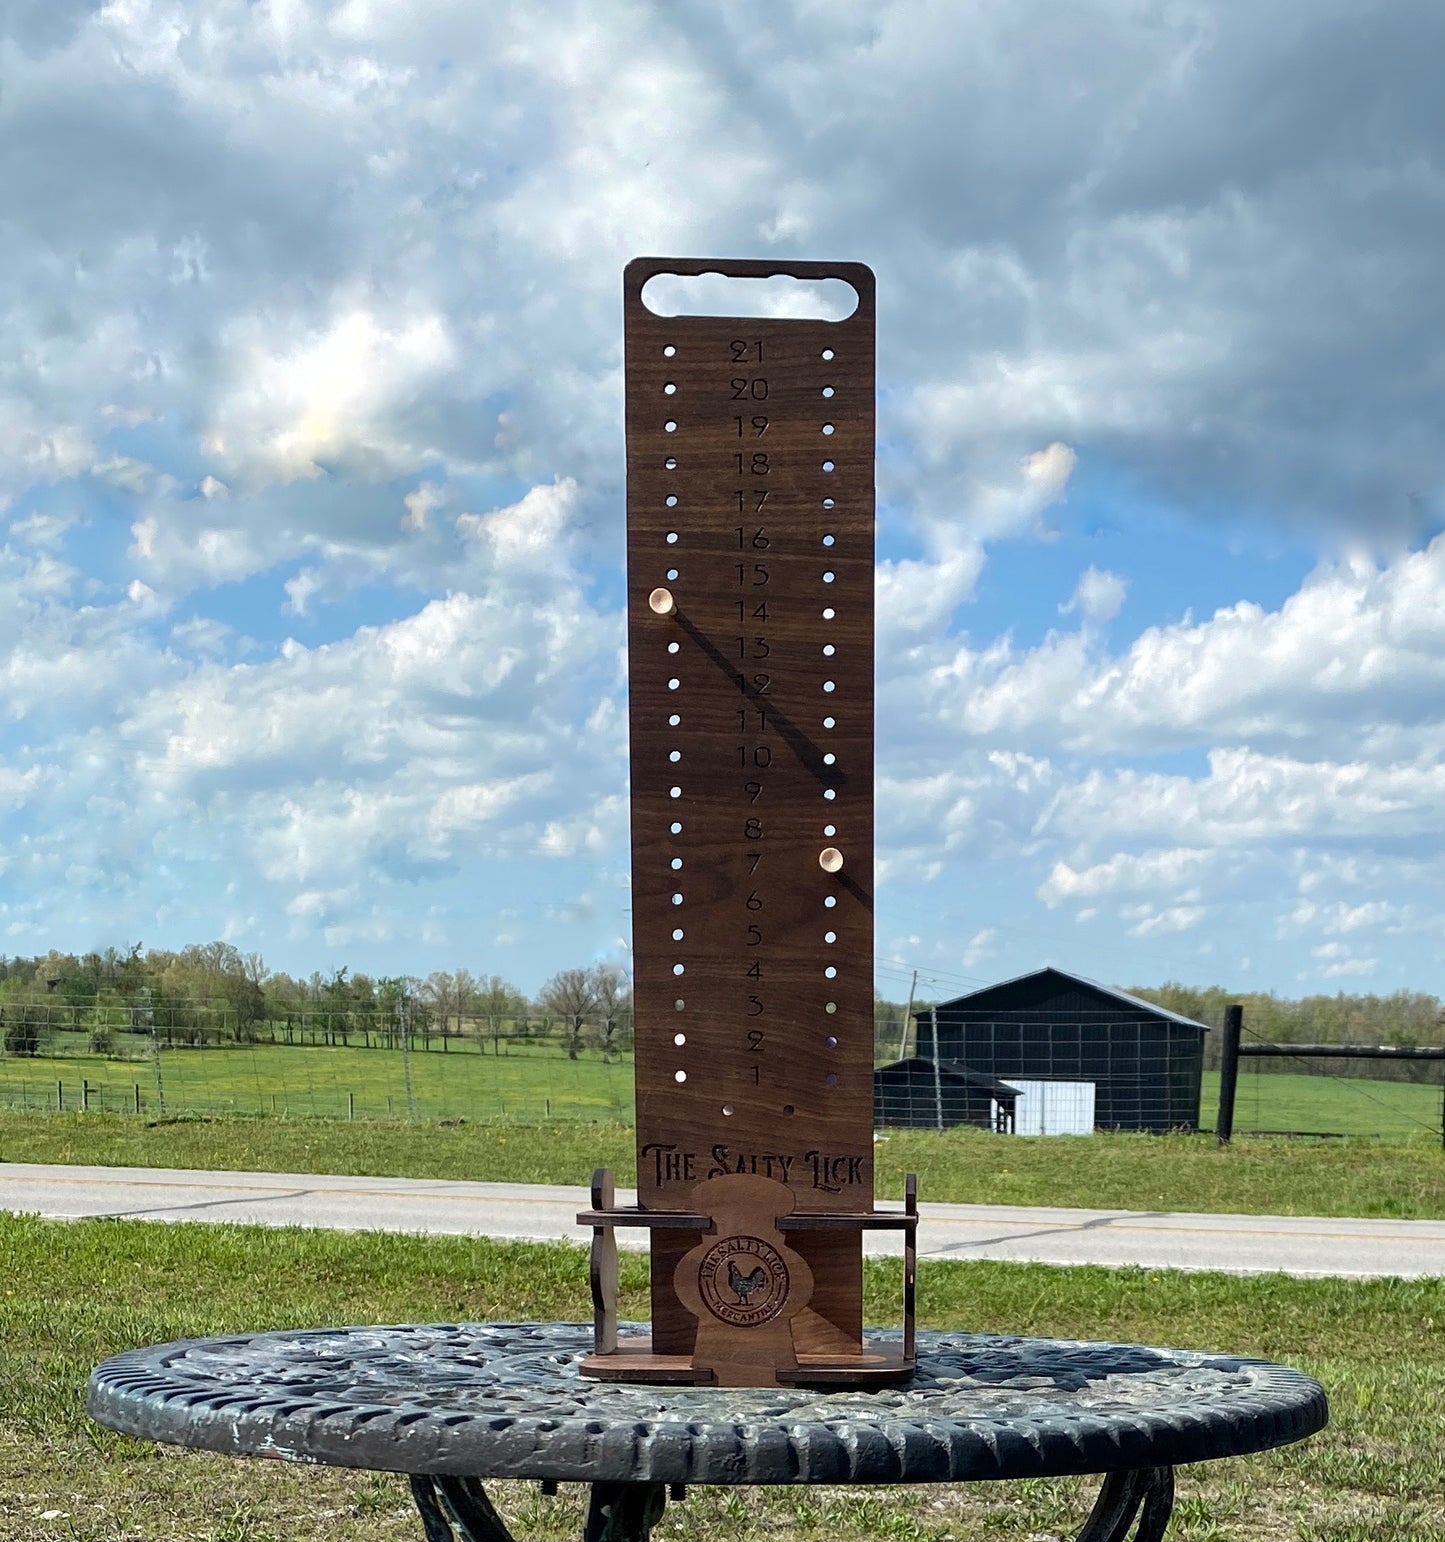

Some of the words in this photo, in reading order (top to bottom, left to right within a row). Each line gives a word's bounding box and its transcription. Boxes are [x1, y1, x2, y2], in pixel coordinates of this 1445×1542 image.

[730, 340, 763, 363] 21
[731, 378, 769, 400] 20
[734, 416, 769, 438] 19
[735, 453, 770, 475] 18
[734, 490, 769, 512] 17
[735, 527, 771, 549] 16
[735, 564, 769, 586] 15
[736, 601, 769, 622] 14
[736, 637, 770, 659] 13
[736, 674, 771, 695] 12
[737, 710, 766, 732] 11
[738, 746, 772, 768] 10
[745, 782, 763, 804] 9
[744, 818, 763, 839] 8
[747, 854, 762, 875] 7
[746, 890, 762, 911] 6
[746, 925, 762, 946] 5
[746, 961, 763, 982] 4
[748, 996, 764, 1016] 3
[747, 1030, 765, 1051] 2
[751, 1066, 760, 1086] 1
[642, 1144, 697, 1187] THE
[805, 1150, 864, 1194] LICK
[701, 1253, 720, 1278] THE
[717, 1240, 765, 1257] SALTY
[763, 1250, 785, 1281] LICK
[713, 1302, 774, 1322] MERCANTILE
